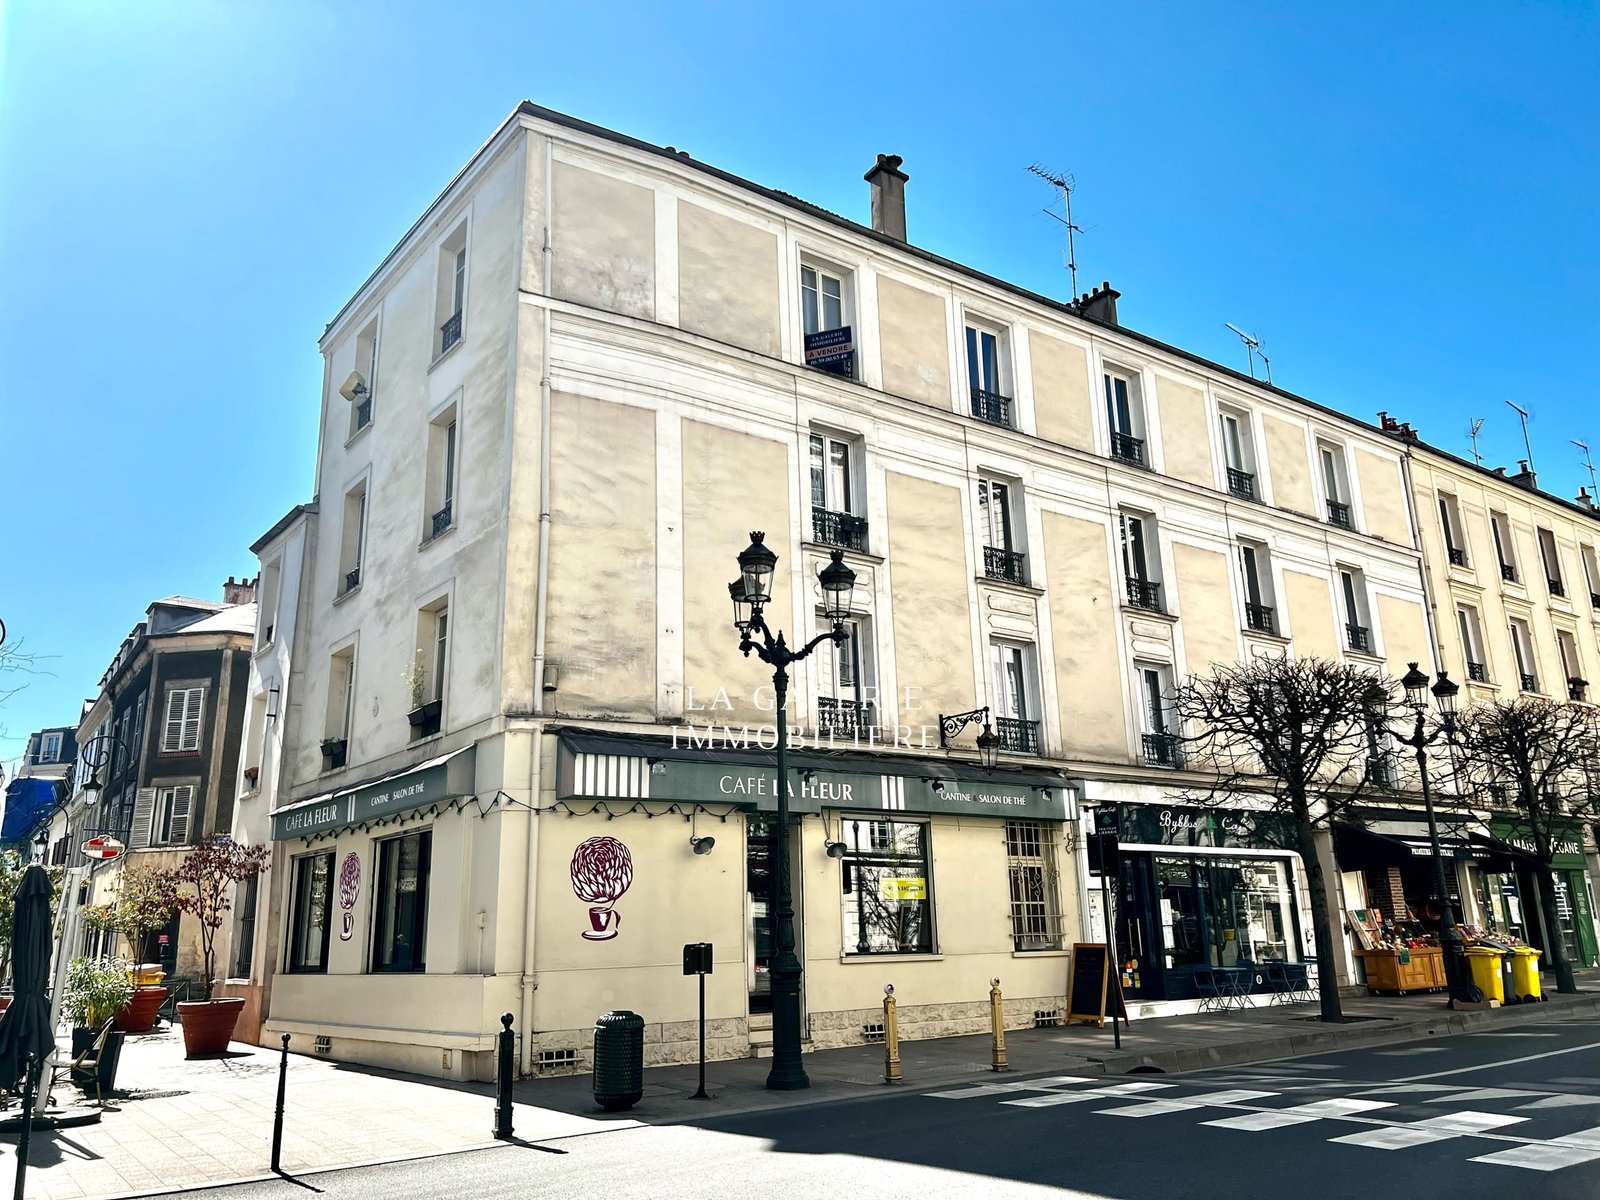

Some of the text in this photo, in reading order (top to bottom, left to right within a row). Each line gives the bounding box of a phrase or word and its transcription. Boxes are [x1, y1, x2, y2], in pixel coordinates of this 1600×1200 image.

[820, 331, 843, 340] GALERIE
[816, 344, 849, 356] VENDRE
[370, 780, 425, 807] CANTINE SALON DE THÉ
[719, 773, 766, 796] CAFÉ
[801, 780, 853, 801] FLEUR
[940, 791, 971, 802] CANTINE
[978, 794, 1001, 804] SALON
[1002, 796, 1013, 805] DE
[1013, 795, 1026, 806] THÉ
[303, 811, 313, 828] LA
[314, 804, 338, 825] FLEUR
[1159, 810, 1200, 834] Byblos
